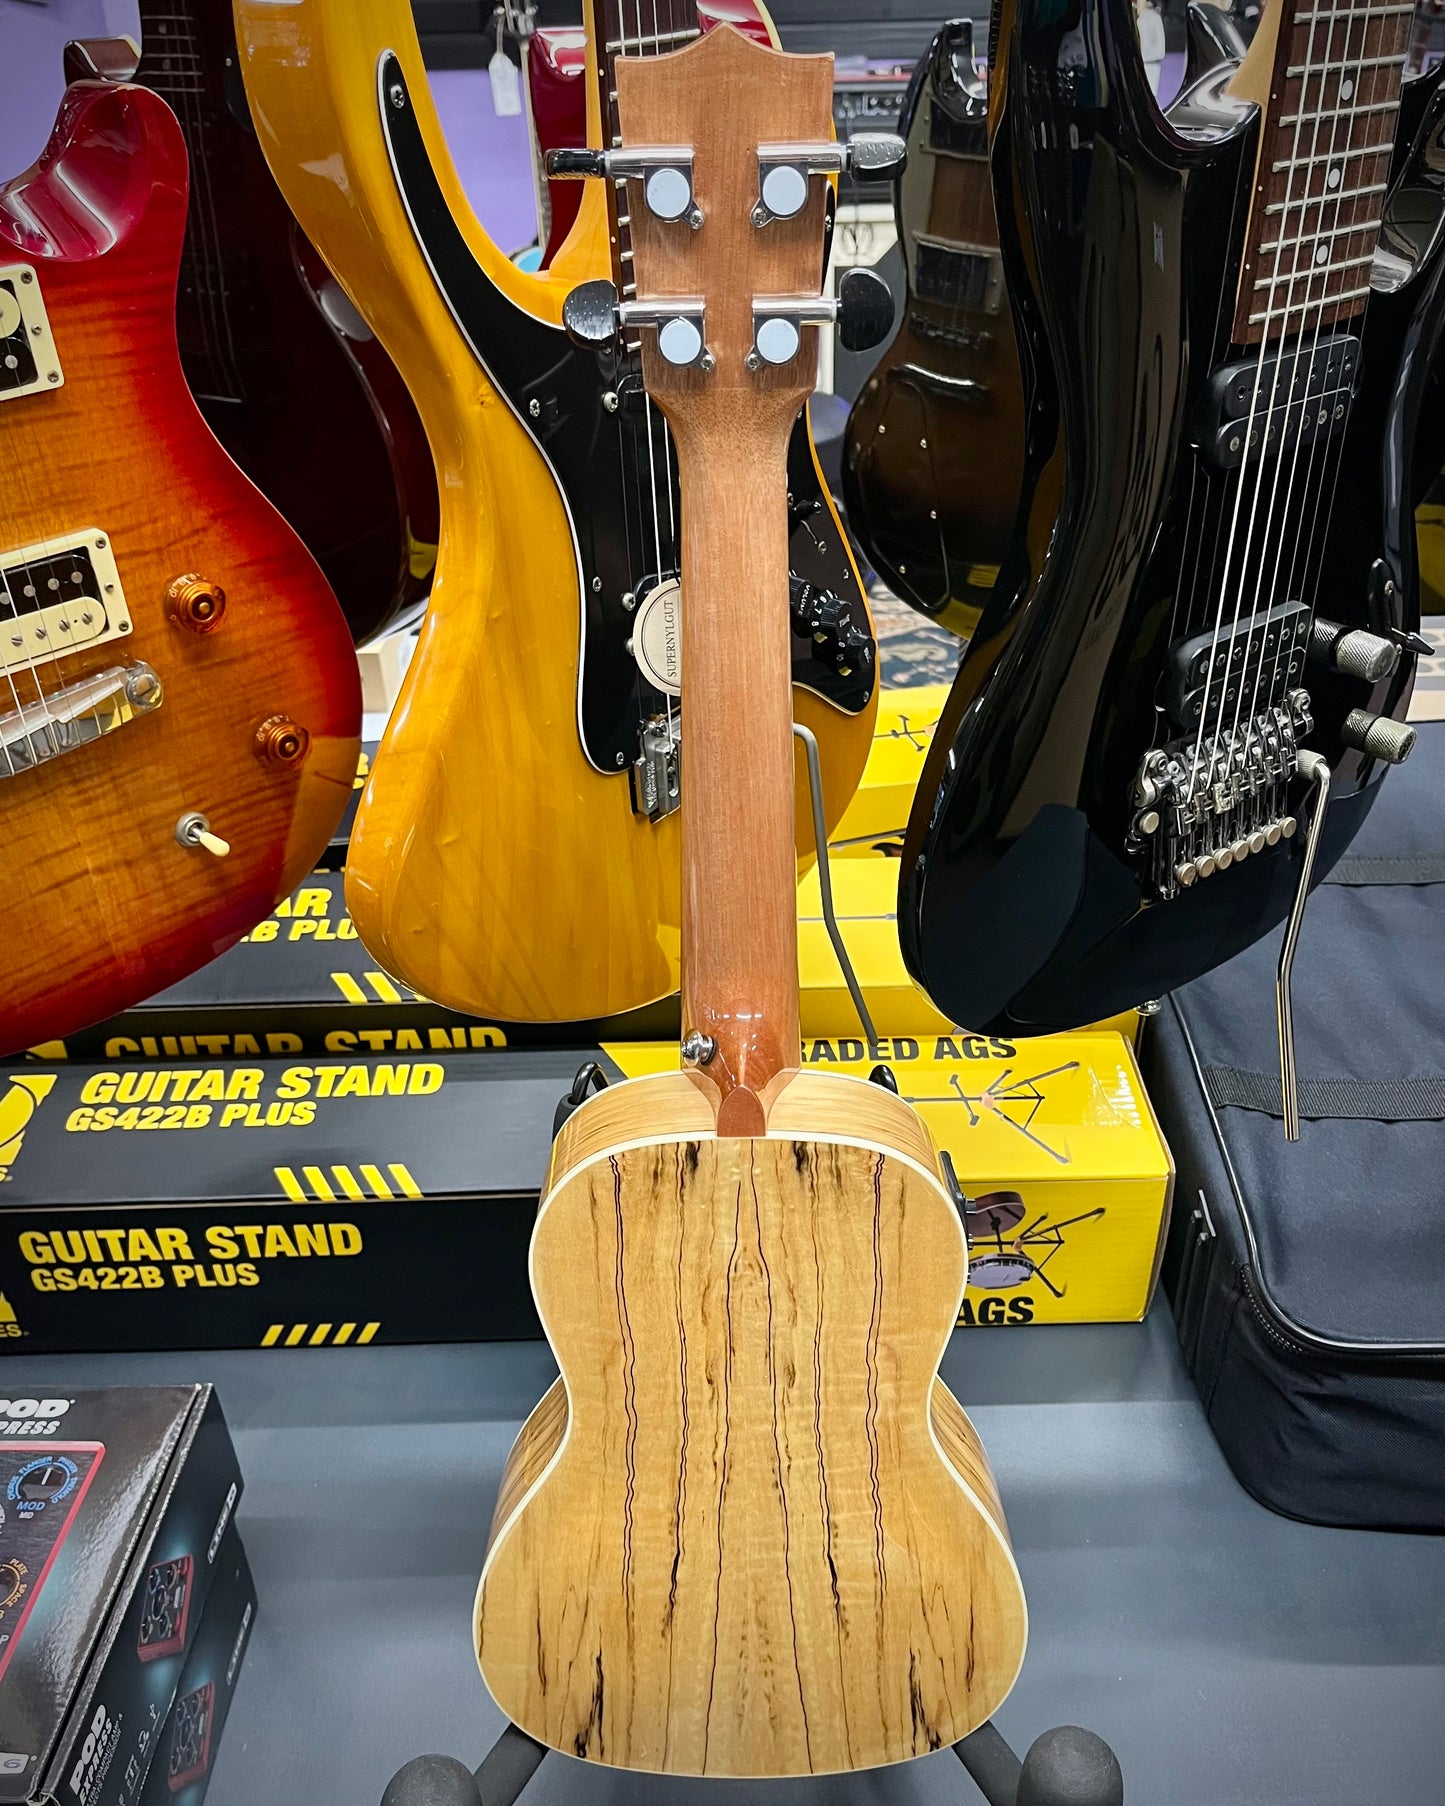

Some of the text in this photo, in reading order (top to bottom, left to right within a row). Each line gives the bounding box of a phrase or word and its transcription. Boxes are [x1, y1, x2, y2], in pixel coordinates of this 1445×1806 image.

[664, 600, 677, 678] SUPERNYLGUT
[288, 918, 360, 941] PLU
[933, 1035, 1018, 1061] AGS
[80, 1063, 446, 1105] GUITAR STAND
[65, 1101, 317, 1132] GS422B PLUS
[18, 1222, 364, 1265] GUITAR STAND
[30, 1264, 261, 1292] GS422B PLUS
[16, 1501, 46, 1511] MOD
[69, 1704, 107, 1796] POD
[79, 1717, 112, 1806] EXPRESS
